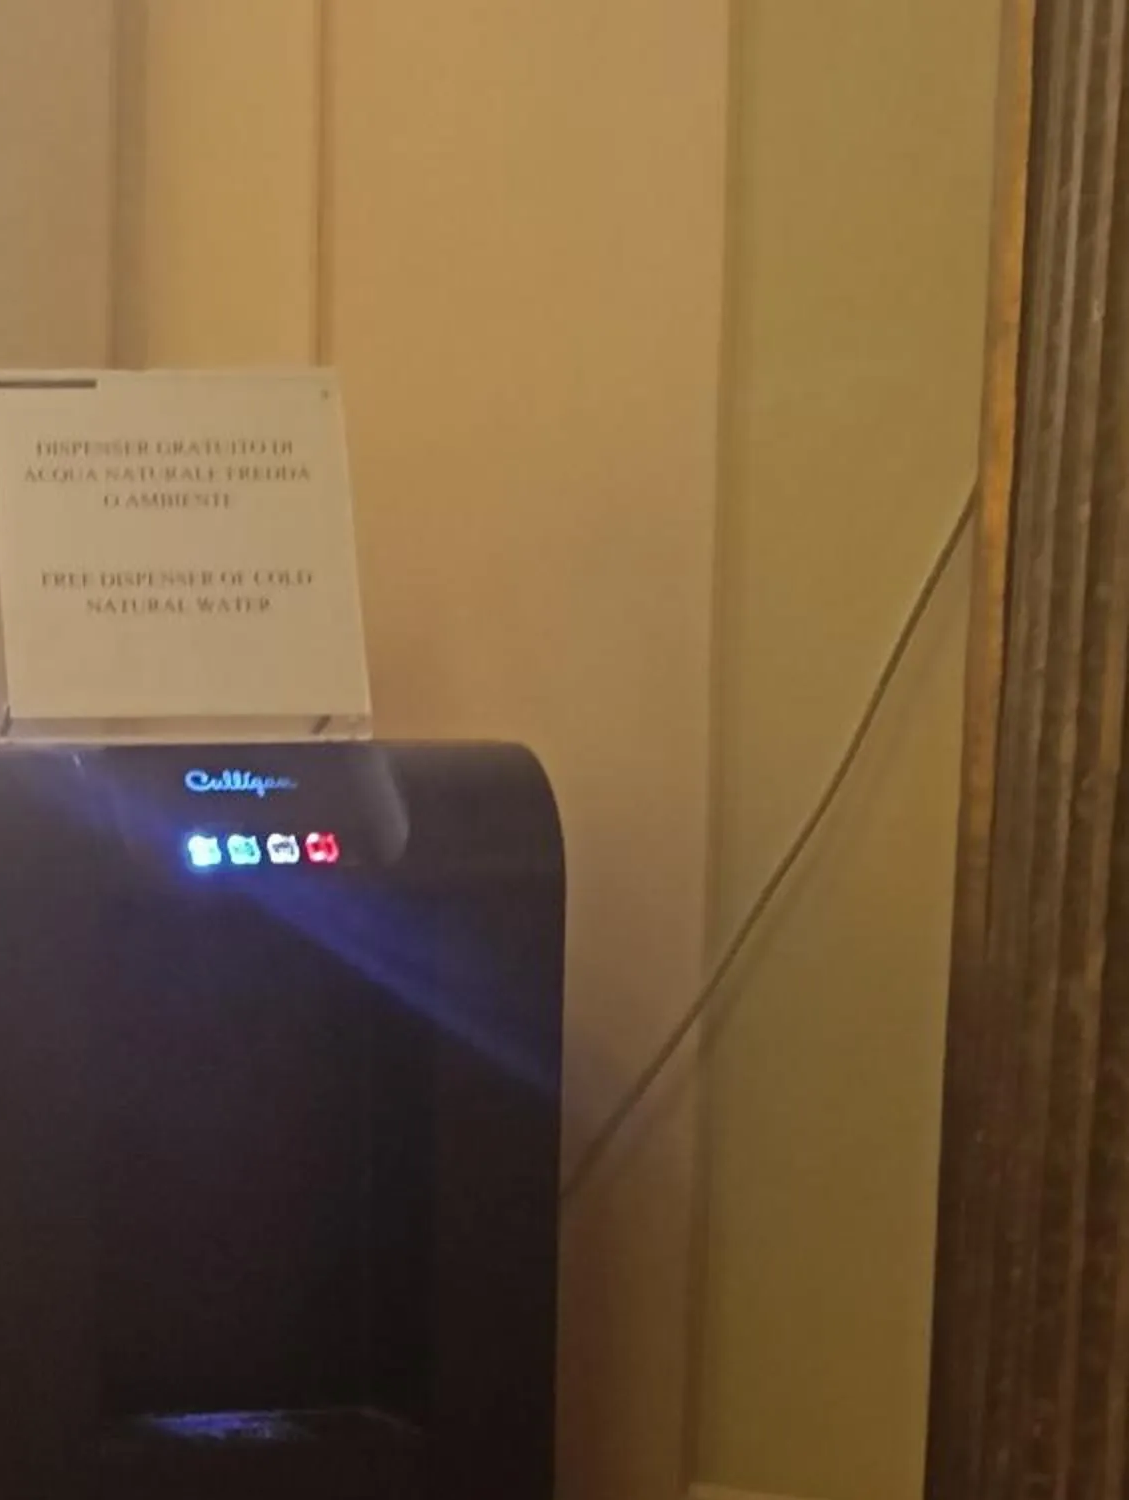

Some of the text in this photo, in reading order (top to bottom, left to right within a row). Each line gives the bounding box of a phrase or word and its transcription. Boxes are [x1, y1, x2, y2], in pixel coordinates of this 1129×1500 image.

[36, 440, 295, 457] DISPENSER GRATUITO DI
[25, 466, 312, 484] ACQUA NATURALE FREDDA
[104, 493, 233, 510] O AMBIENTE
[41, 570, 314, 589] FREE DISPENSER OF COLD
[87, 597, 273, 616] NATURAL WATER
[184, 769, 298, 798] Culligan
